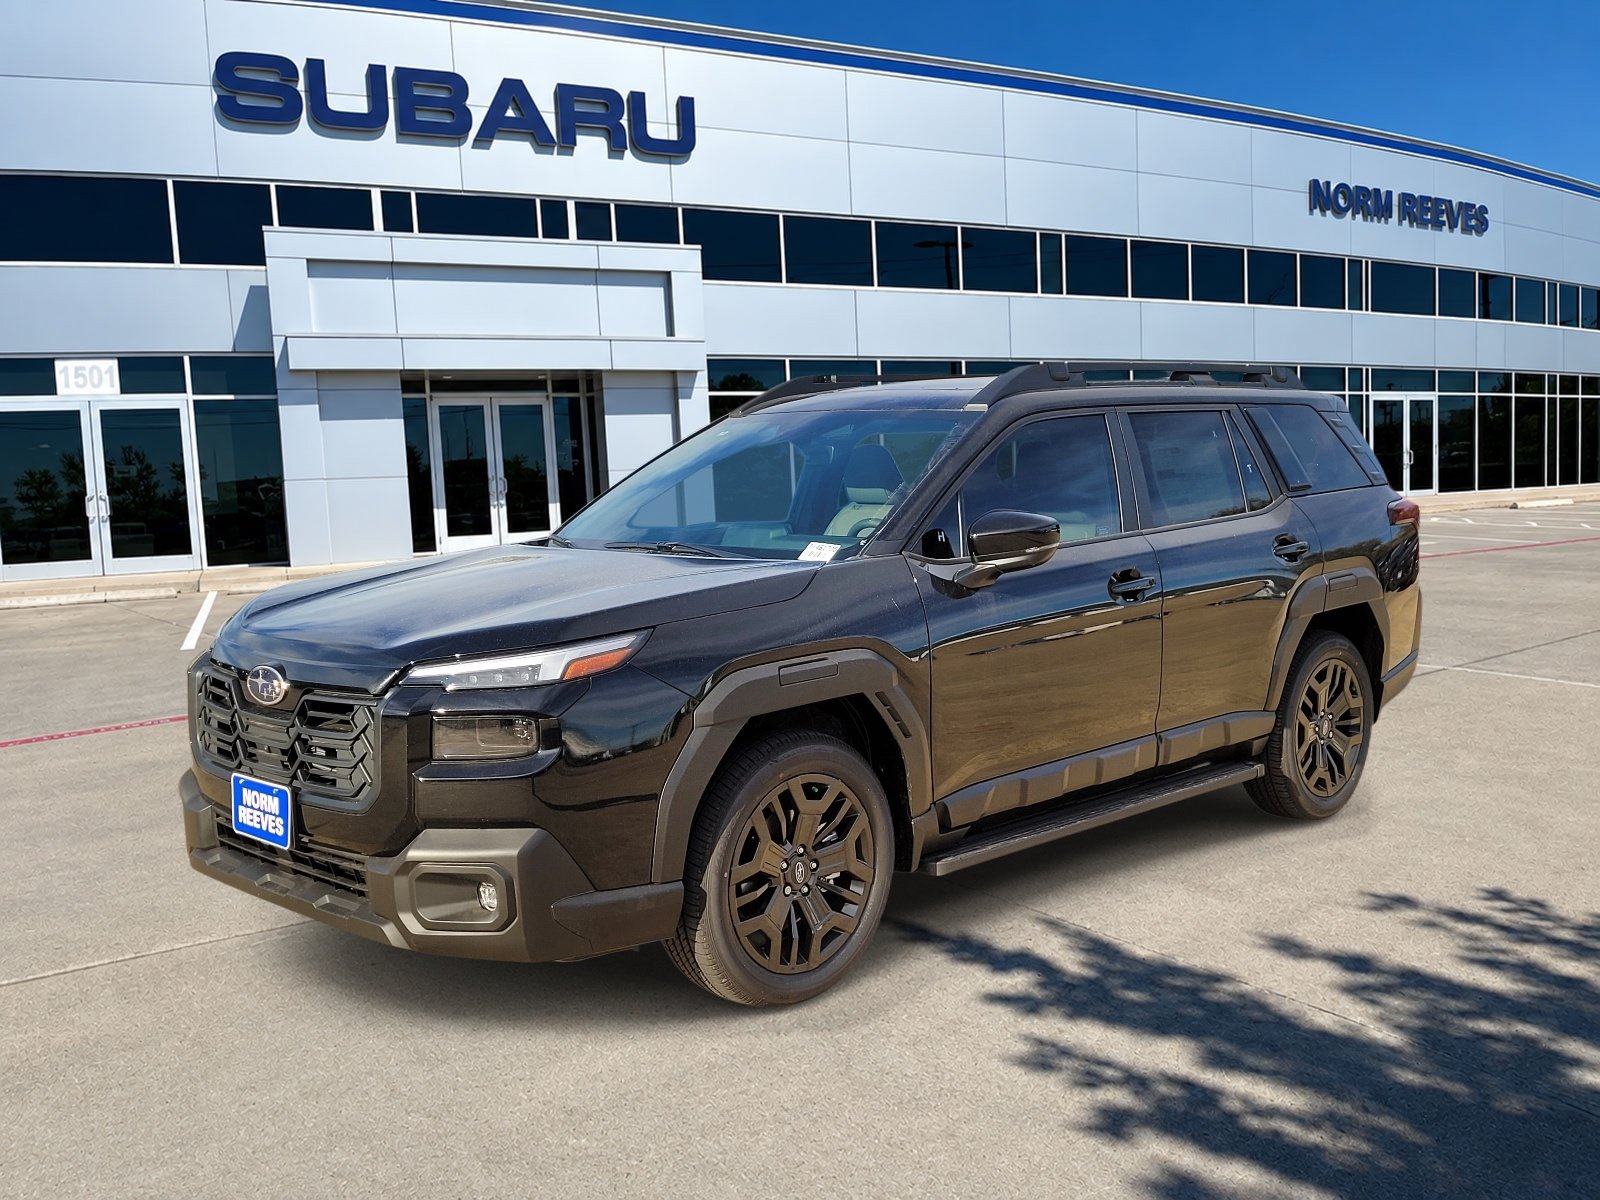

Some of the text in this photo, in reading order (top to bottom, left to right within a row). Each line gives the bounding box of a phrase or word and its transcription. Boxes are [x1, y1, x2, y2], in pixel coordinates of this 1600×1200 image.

[214, 51, 697, 159] SUBARU
[1309, 179, 1489, 235] NORM REEVES
[59, 365, 115, 389] 1501
[242, 787, 280, 816] NORM
[238, 805, 285, 837] REEVES
